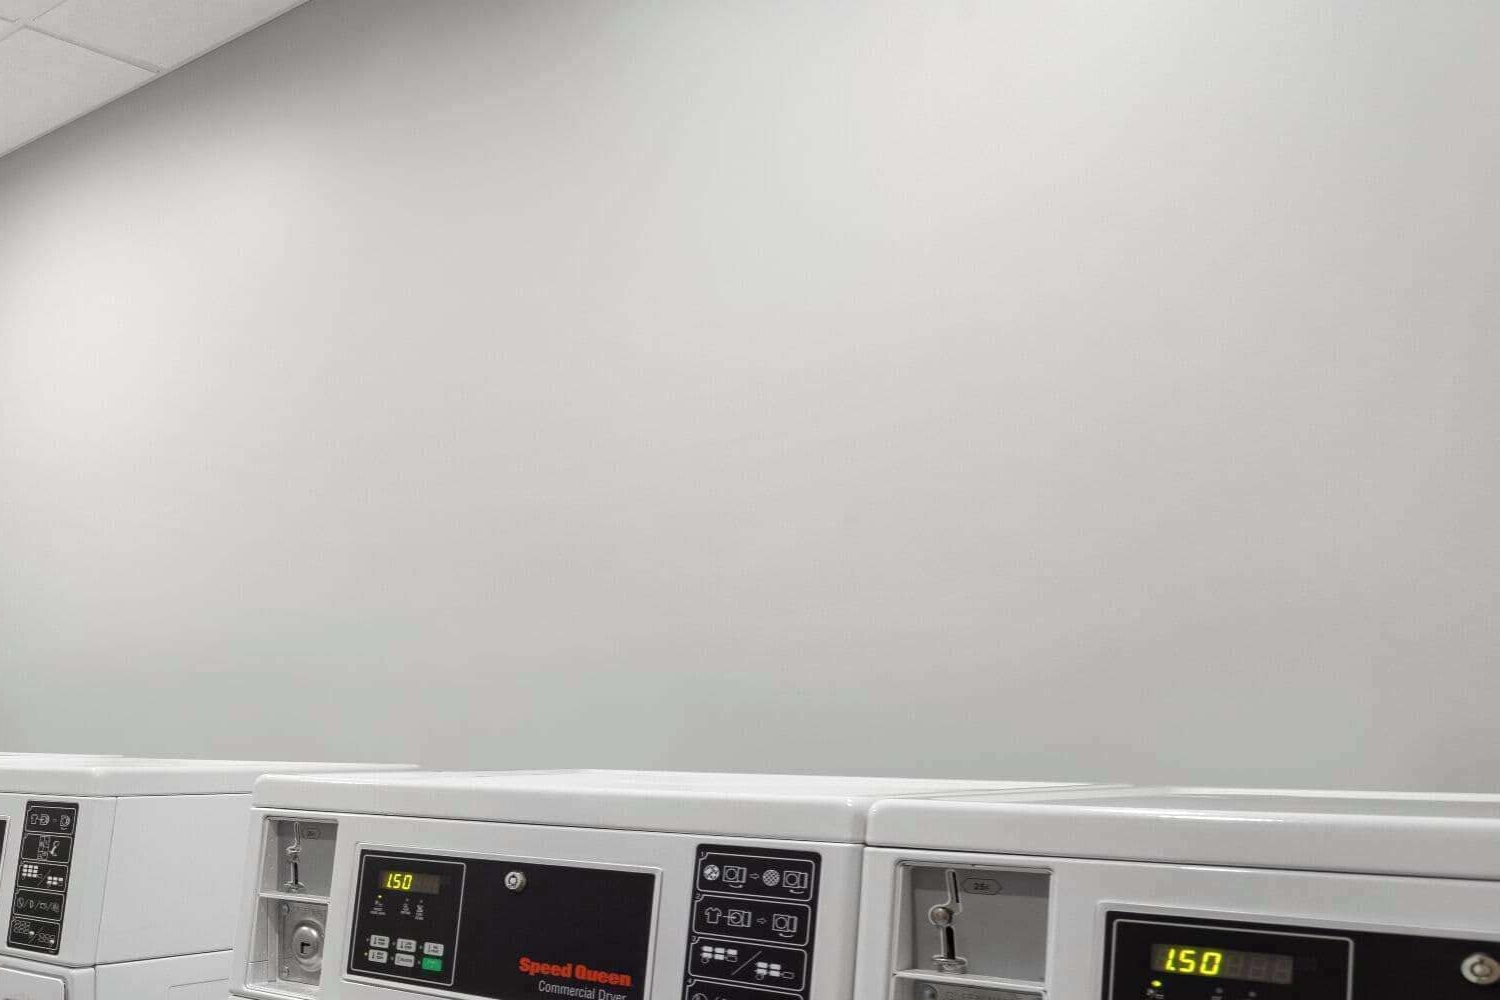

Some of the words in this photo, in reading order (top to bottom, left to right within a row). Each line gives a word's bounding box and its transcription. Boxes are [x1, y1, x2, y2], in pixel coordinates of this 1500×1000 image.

[519, 957, 572, 977] Speed
[575, 965, 631, 987] Queen
[1165, 948, 1222, 975] 1.50
[538, 980, 595, 999] Commercial
